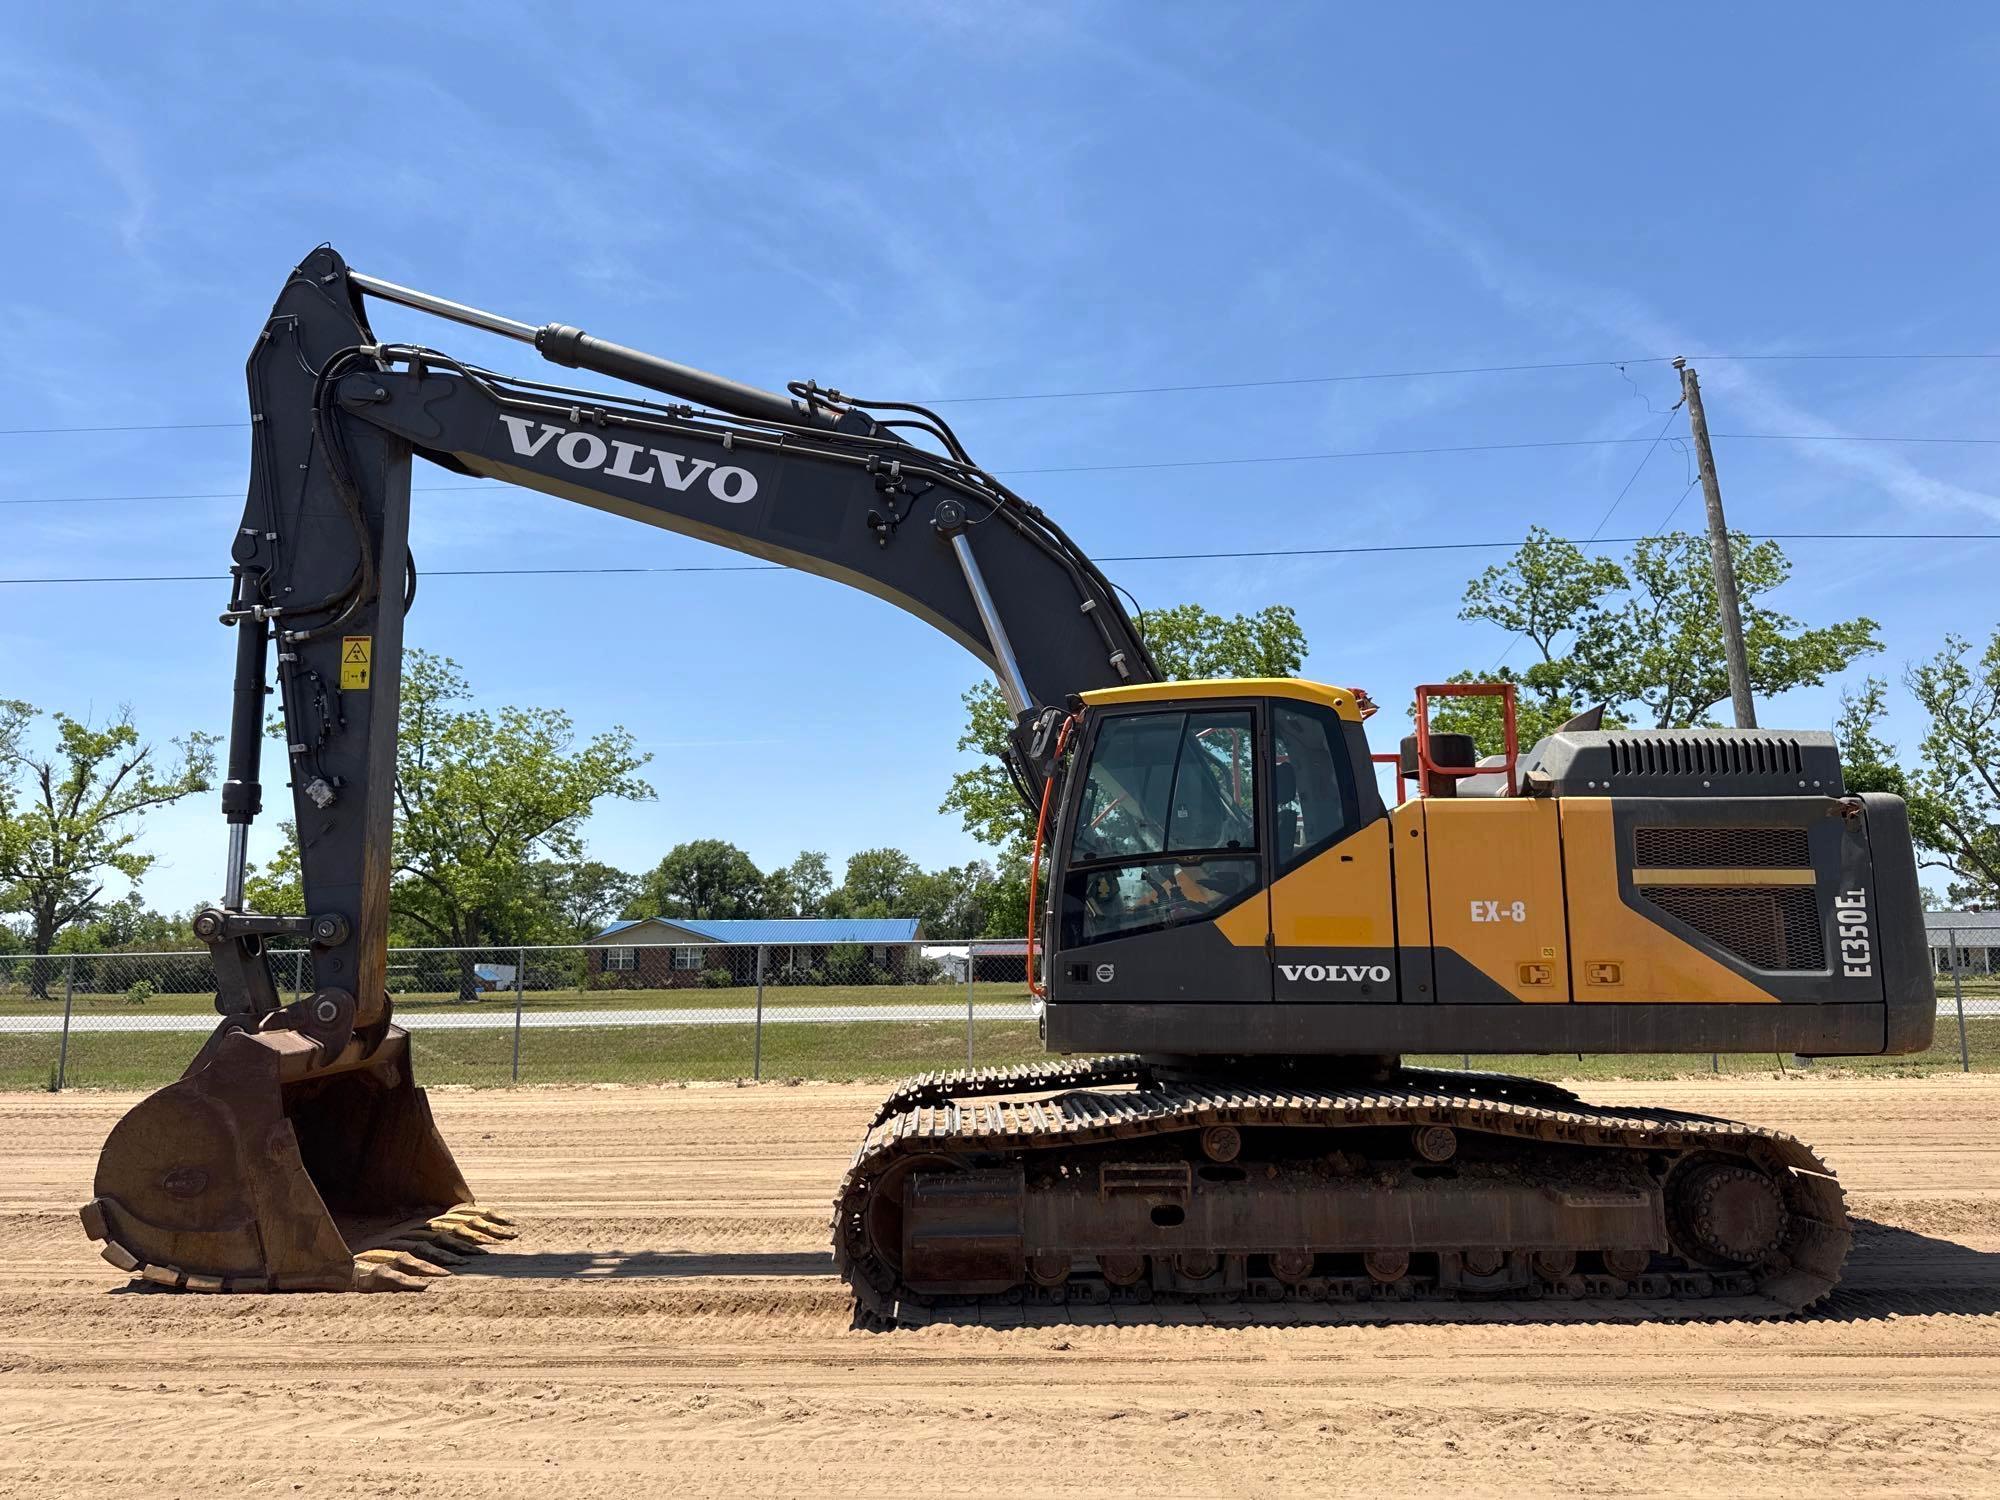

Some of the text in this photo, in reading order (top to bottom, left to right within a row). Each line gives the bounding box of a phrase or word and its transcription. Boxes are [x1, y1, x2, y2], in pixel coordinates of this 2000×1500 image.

[499, 414, 758, 503] VOLVO
[1471, 901, 1526, 922] EX-8
[1835, 888, 1872, 977] EC350EL
[1278, 965, 1391, 982] VOLVO
